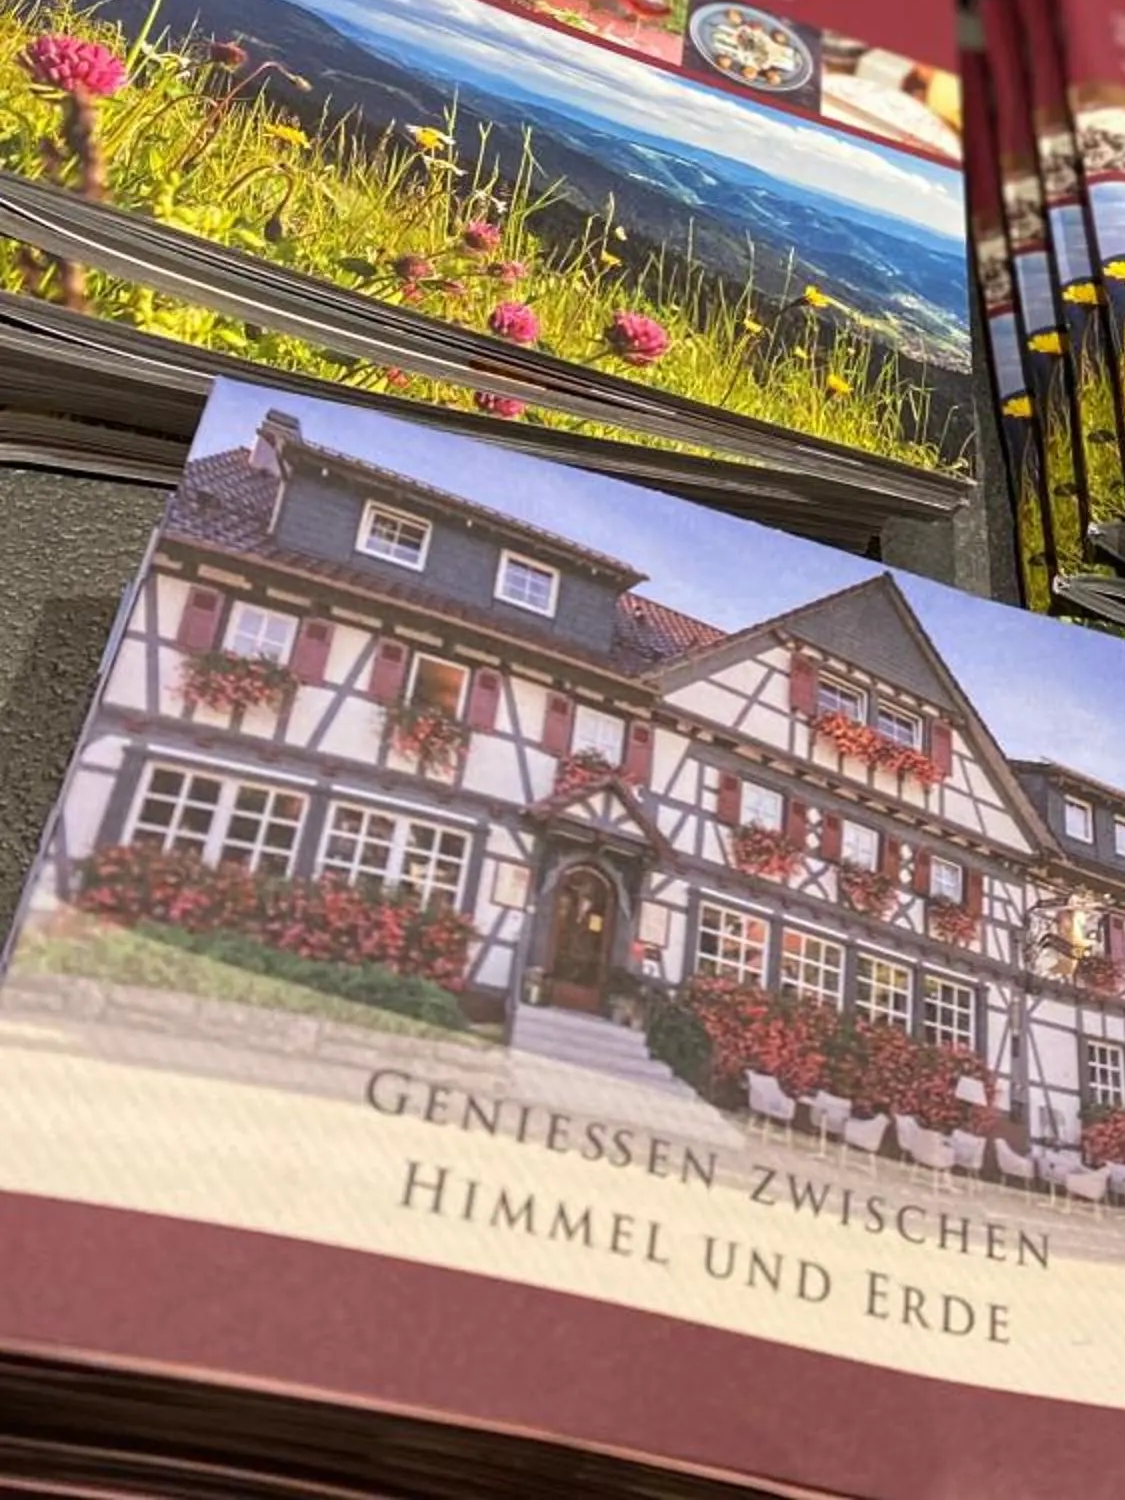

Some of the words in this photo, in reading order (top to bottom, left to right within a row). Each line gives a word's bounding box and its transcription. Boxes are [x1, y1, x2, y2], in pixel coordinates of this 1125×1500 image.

[365, 1067, 719, 1190] GENIESSEN
[749, 1163, 1052, 1272] ZWISCHEN
[401, 1160, 671, 1266] HIMMEL
[702, 1234, 834, 1304] UND
[865, 1269, 1013, 1346] ERDE
